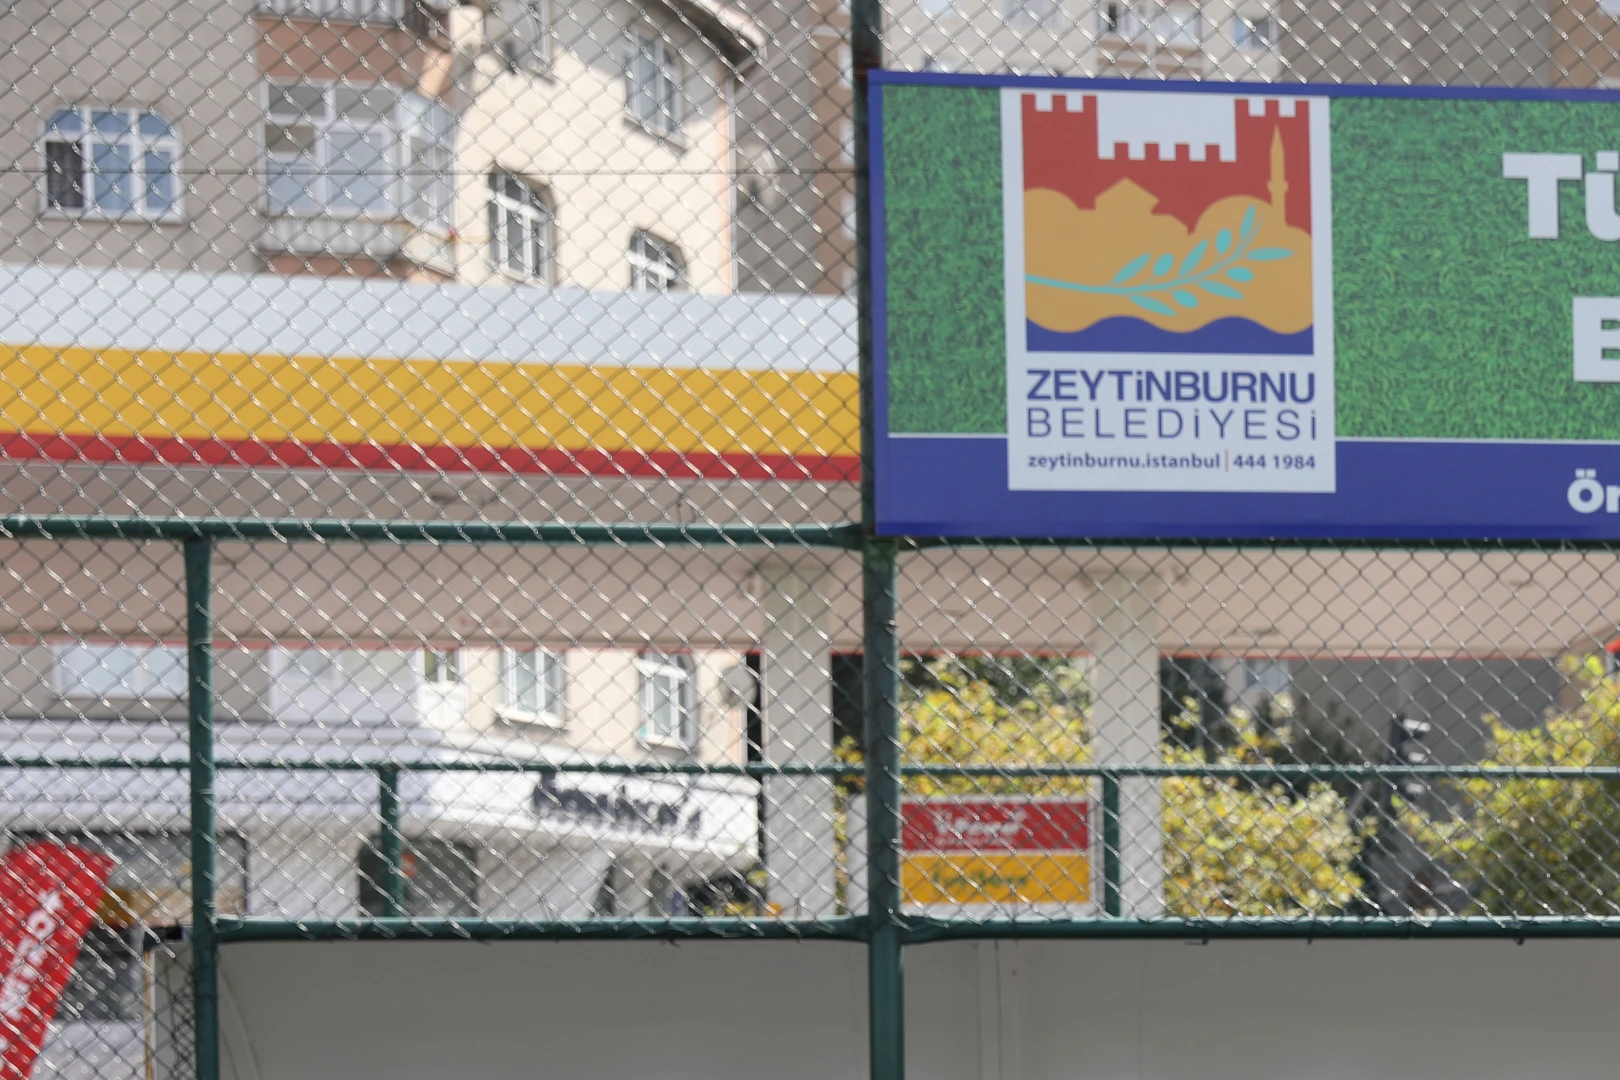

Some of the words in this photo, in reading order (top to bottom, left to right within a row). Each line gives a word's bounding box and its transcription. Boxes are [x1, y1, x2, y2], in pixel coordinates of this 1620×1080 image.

[1028, 453, 1221, 472] zeytinburnu.istanbul
[1233, 455, 1268, 470] 444
[1273, 455, 1317, 471] 1984
